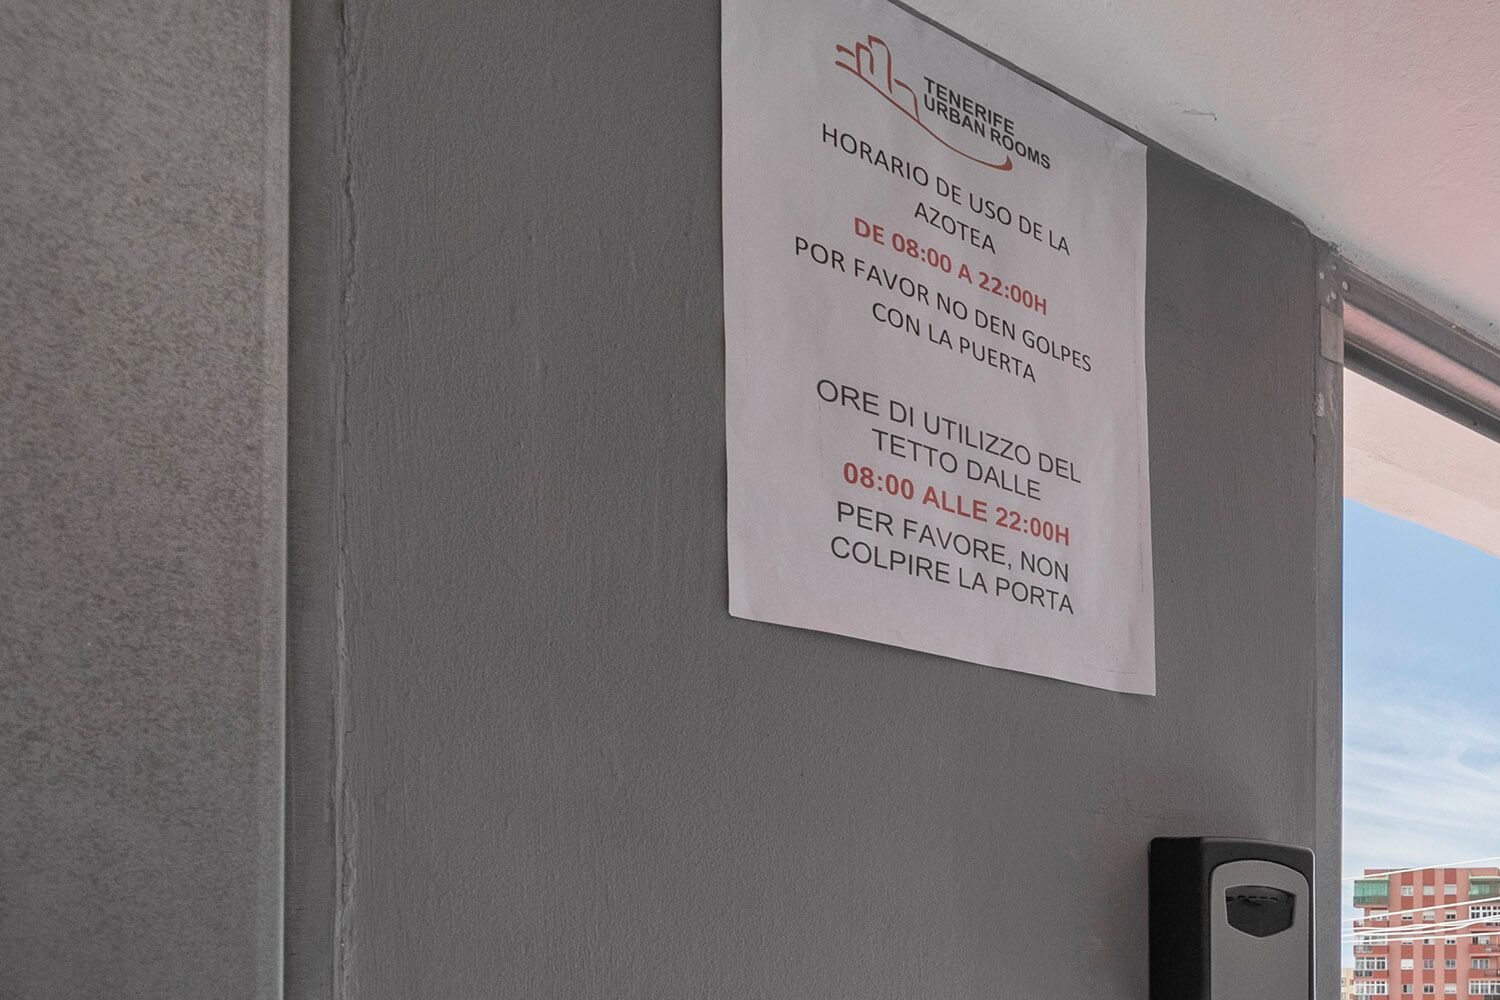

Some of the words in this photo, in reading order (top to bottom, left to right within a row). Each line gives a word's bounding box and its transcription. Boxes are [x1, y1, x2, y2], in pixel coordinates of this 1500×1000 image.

[923, 76, 1015, 137] TENERIFE
[923, 93, 986, 139] URBAN
[990, 127, 1052, 170] ROOMS
[821, 123, 929, 187] HORARIO
[935, 175, 962, 205] DE
[968, 192, 1013, 227] USO
[1018, 215, 1043, 242] DE
[1048, 229, 1071, 256] LA
[913, 201, 997, 255] AZOTEA
[795, 235, 846, 274] POR
[853, 258, 930, 305] FAVOR
[936, 291, 969, 321] NO
[974, 309, 1016, 341] DEN
[1022, 329, 1092, 373] GOLPES
[853, 216, 885, 247] DE
[891, 231, 953, 275] 08:00
[957, 263, 973, 284] A
[977, 270, 1048, 316] 22:00H
[871, 302, 921, 337] CON
[928, 322, 953, 351] LA
[959, 336, 1037, 383] PUERTA
[815, 378, 880, 416] ORE
[889, 399, 915, 428] DI
[923, 410, 1032, 466] UTILIZZO
[1038, 451, 1082, 484] DEL
[871, 427, 959, 474] TETTO
[966, 458, 1041, 501] DALLE
[837, 500, 894, 537] PER
[902, 518, 1013, 571] FAVORE,
[1020, 550, 1070, 583] NON
[842, 461, 915, 501] 08:00
[921, 485, 989, 522] ALLE
[994, 506, 1071, 546] 22:00H
[829, 535, 951, 584] COLPIRE
[958, 566, 989, 594] LA
[994, 575, 1074, 615] PORTA
